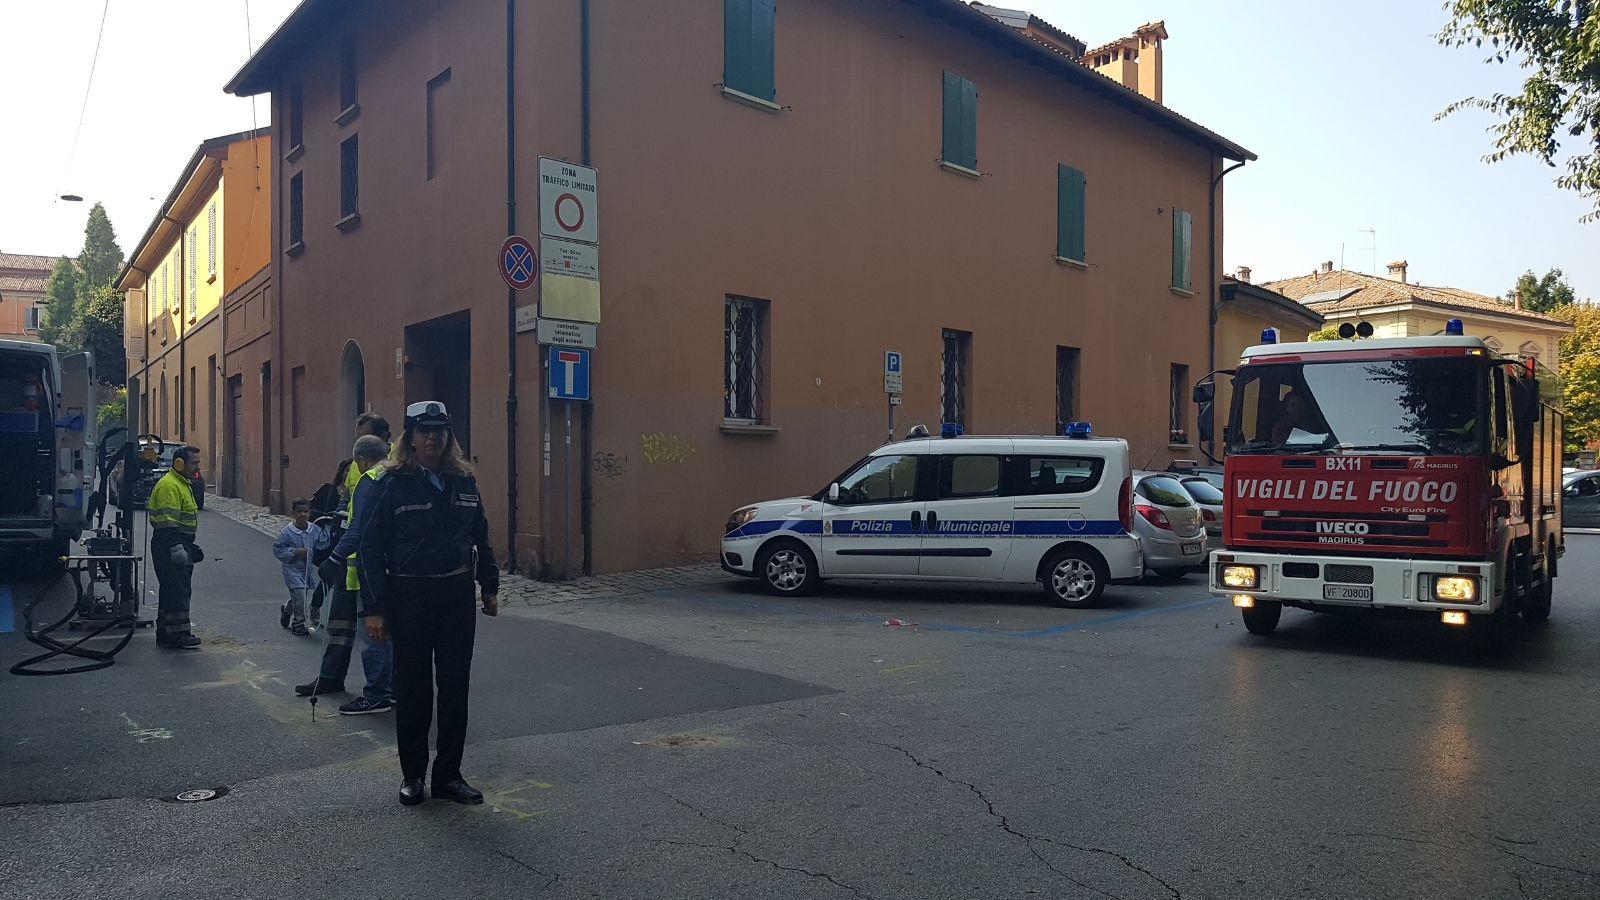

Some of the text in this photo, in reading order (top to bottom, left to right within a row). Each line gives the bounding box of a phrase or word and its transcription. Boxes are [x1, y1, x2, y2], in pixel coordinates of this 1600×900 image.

[561, 167, 577, 178] ZONA
[542, 174, 595, 193] TRAFFICO LIMITATO
[890, 355, 898, 370] P
[1325, 457, 1361, 471] BX11
[1237, 478, 1458, 503] VIGILI DEL FUOCO
[1380, 506, 1401, 514] City
[851, 520, 1011, 534] Polizia Municipale
[1315, 521, 1369, 535] IVECO
[1318, 536, 1365, 545] MAGIRUS
[1342, 588, 1370, 599] 20800
